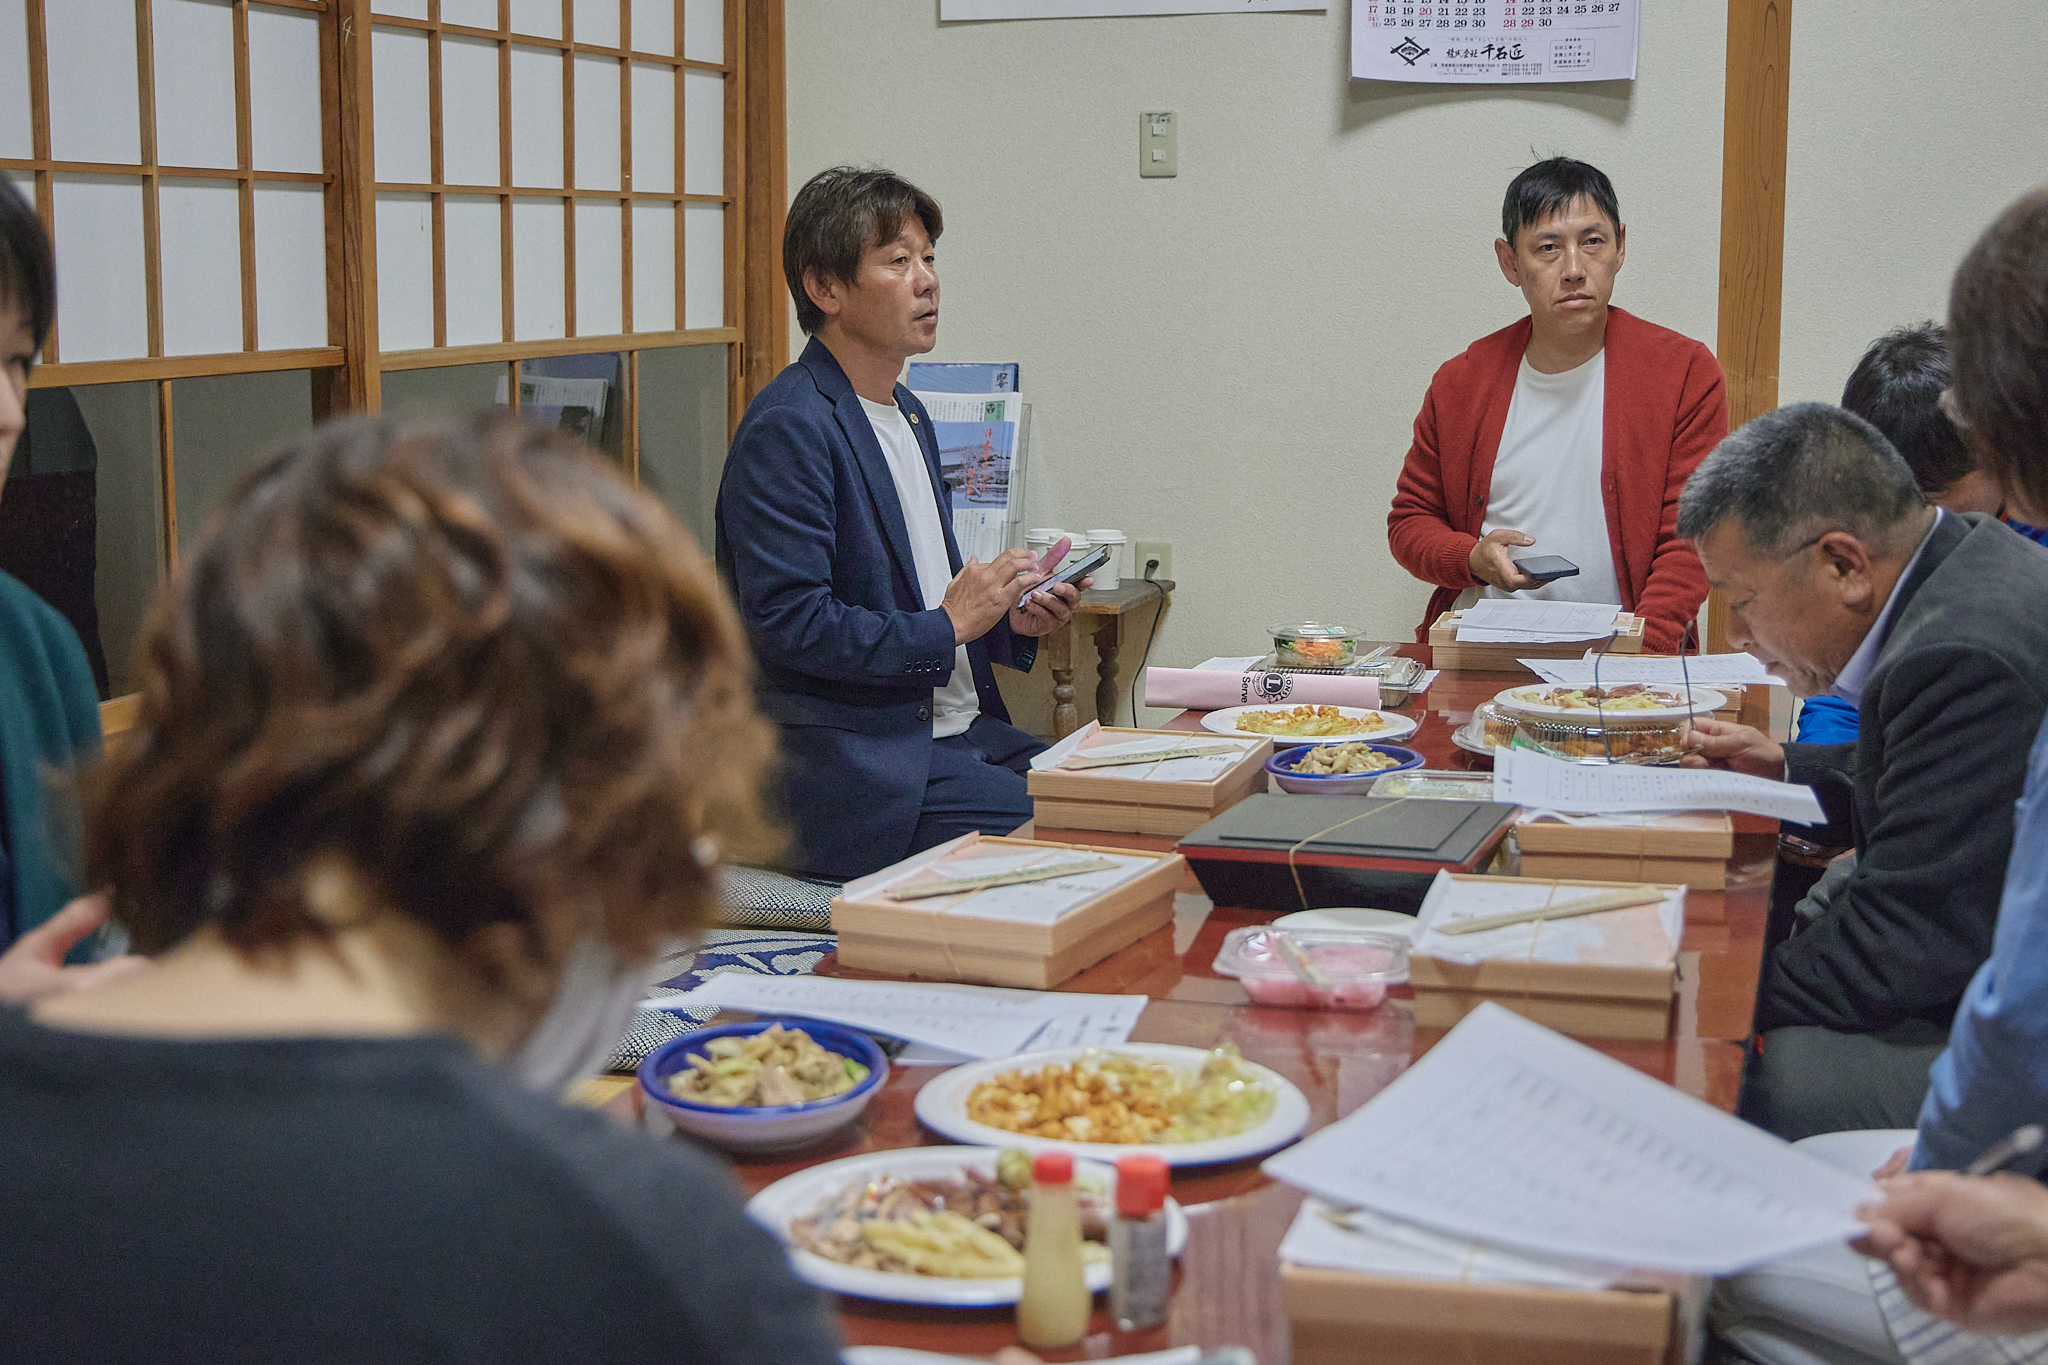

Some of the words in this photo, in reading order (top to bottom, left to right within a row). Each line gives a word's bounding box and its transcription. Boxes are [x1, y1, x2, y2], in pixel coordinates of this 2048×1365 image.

[1369, 5, 1378, 13] 17
[1386, 6, 1396, 14] 18
[1403, 7, 1413, 15] 19
[1419, 7, 1432, 15] 20
[1438, 8, 1449, 16] 21
[1455, 8, 1467, 16] 22
[1473, 8, 1485, 16] 23
[1505, 7, 1516, 15] 21
[1522, 7, 1534, 15] 22
[1539, 6, 1552, 15] 23
[1557, 6, 1569, 14] 24
[1574, 5, 1587, 13] 25
[1592, 4, 1604, 13] 26
[1609, 3, 1620, 12] 27
[1384, 18, 1396, 26] 25
[1401, 19, 1414, 27] 26
[1419, 19, 1431, 27] 27
[1437, 19, 1449, 27] 28
[1472, 19, 1485, 28] 30
[1503, 19, 1516, 27] 28
[1521, 19, 1534, 27] 29
[1539, 19, 1552, 27] 30
[1266, 678, 1281, 689] L
[1283, 673, 1292, 696] LIONS
[1241, 676, 1251, 703] Serve
